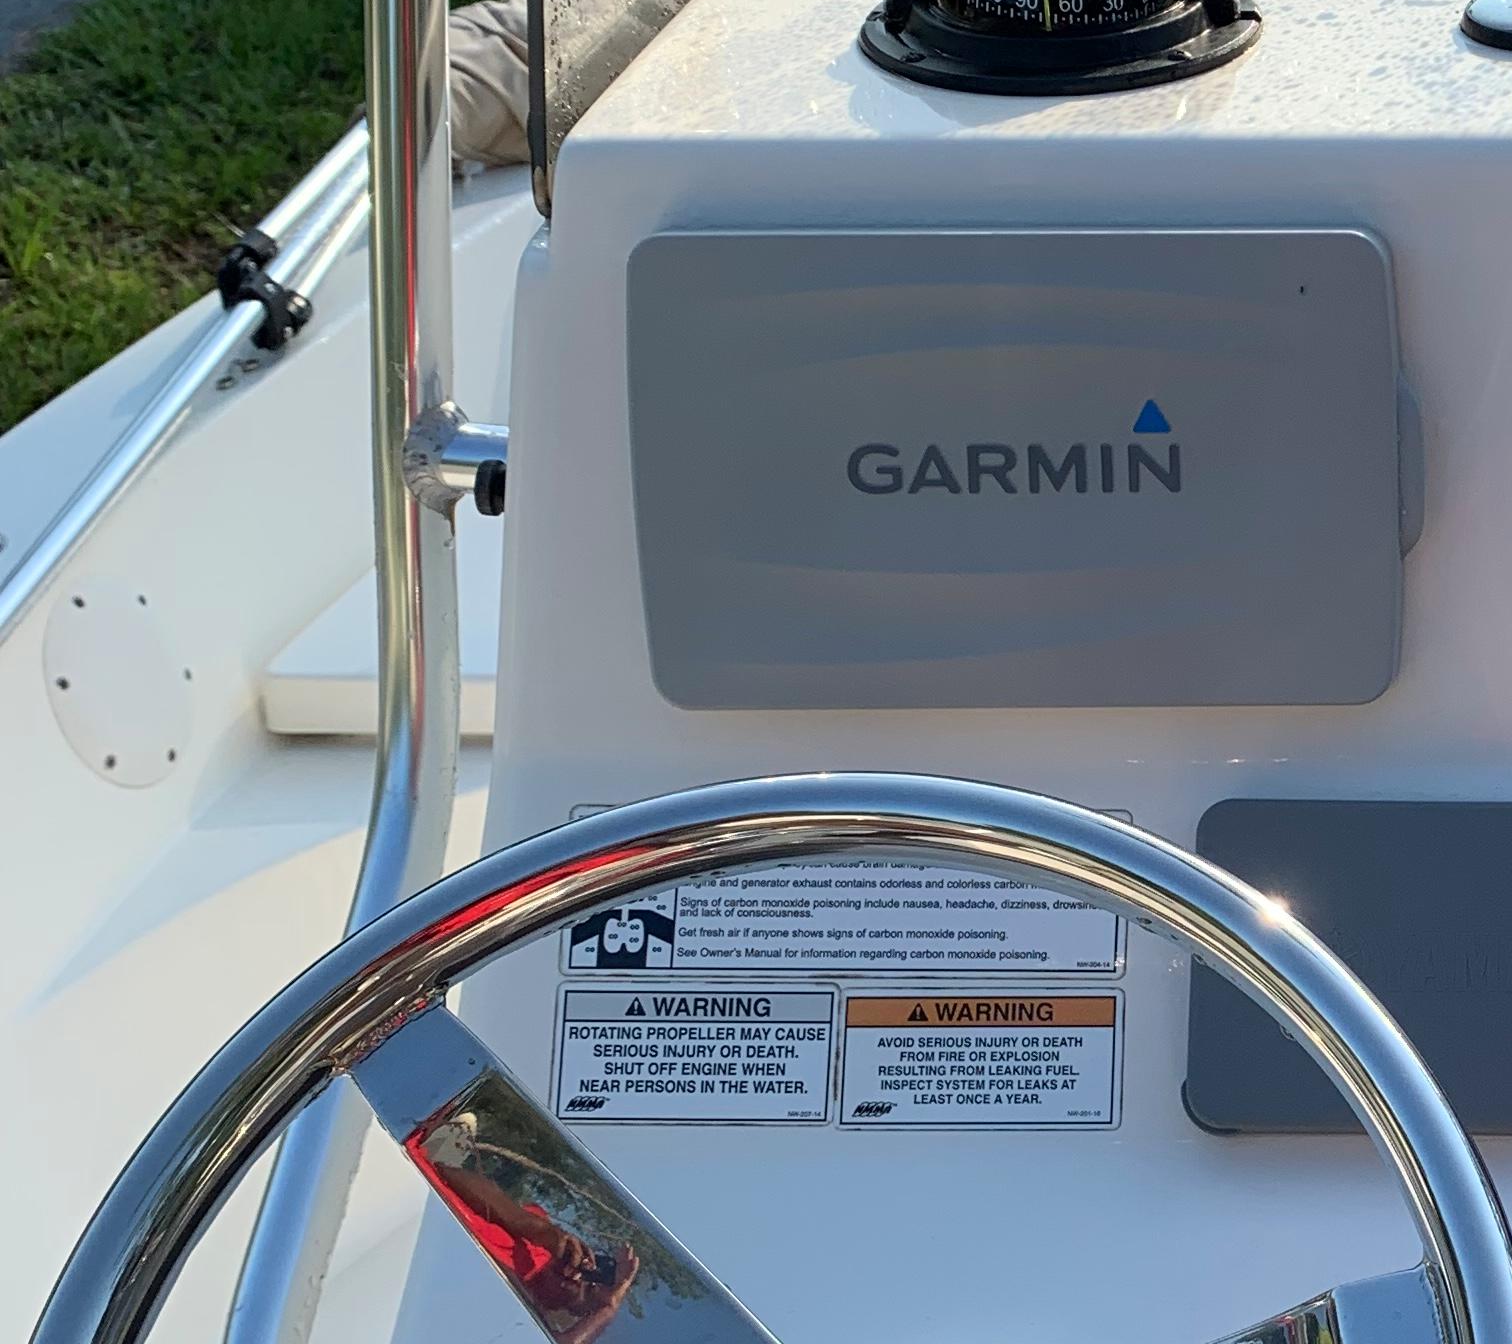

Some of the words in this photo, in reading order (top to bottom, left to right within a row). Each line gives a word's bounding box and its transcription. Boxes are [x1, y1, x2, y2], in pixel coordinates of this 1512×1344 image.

[846, 443, 1182, 495] GARMIN
[681, 878, 717, 889] ngine
[719, 878, 738, 887] and
[741, 878, 790, 889] generator
[792, 878, 832, 888] exhaust
[834, 878, 876, 888] contains
[879, 879, 922, 888] odorless
[925, 879, 943, 889] and
[946, 879, 990, 889] colorless
[680, 896, 708, 908] Signs
[711, 896, 721, 907] of
[723, 897, 758, 908] carbon
[761, 897, 810, 908] monoxide
[813, 898, 861, 910] poisoning
[864, 898, 899, 908] include
[902, 900, 942, 909] nausea,
[945, 899, 997, 910] headache,
[1001, 899, 1049, 910] dizziness,
[1052, 898, 1098, 909] drowsin
[679, 907, 698, 917] and
[701, 907, 721, 917] lack
[724, 907, 734, 917] of
[736, 907, 815, 918] consciousness.
[678, 927, 696, 937] Get
[699, 927, 724, 937] fresh
[727, 928, 740, 937] air
[743, 927, 750, 937] if
[752, 929, 789, 940] anyone
[792, 928, 823, 938] shows
[826, 928, 853, 941] signs
[856, 928, 866, 938] of
[868, 929, 902, 938] carbon
[906, 928, 954, 939] monoxide
[957, 929, 1007, 941] poisoning.
[677, 947, 697, 957] See
[700, 947, 741, 958] Owner's
[744, 947, 781, 958] Manual
[784, 948, 798, 958] for
[801, 948, 856, 958] information
[859, 948, 907, 961] regarding
[910, 949, 944, 959] carbon
[947, 949, 996, 959] monoxide
[999, 949, 1049, 962] poisoning.
[652, 997, 770, 1017] WARNING
[935, 1002, 1052, 1022] WARNING
[569, 1026, 641, 1039] ROTATING
[646, 1026, 735, 1040] PROPELLER
[740, 1027, 771, 1040] MAY
[775, 1027, 825, 1041] CAUSE
[877, 1037, 914, 1048] AVOID
[918, 1037, 971, 1048] SERIOUS
[975, 1037, 1018, 1048] INJURY
[1021, 1037, 1039, 1047] OR
[1043, 1037, 1082, 1047] DEATH
[593, 1044, 658, 1057] SERIOUS
[663, 1044, 715, 1058] INJURY
[720, 1045, 741, 1058] OR
[746, 1045, 798, 1058] DEATH.
[900, 1051, 934, 1062] FROM
[938, 1051, 964, 1062] FIRE
[969, 1051, 986, 1062] OR
[990, 1051, 1059, 1062] EXPLOSION
[604, 1062, 644, 1075] SHUT
[648, 1062, 677, 1075] OFF
[681, 1062, 736, 1076] ENGINE
[741, 1063, 785, 1076] WHEN
[878, 1065, 945, 1076] RESULTING
[950, 1065, 984, 1076] FROM
[988, 1065, 1041, 1076] LEAKING
[1045, 1065, 1079, 1076] FUEL.
[579, 1079, 620, 1092] NEAR
[625, 1079, 695, 1093] PERSONS
[700, 1080, 714, 1093] IN
[719, 1080, 748, 1093] THE
[753, 1080, 807, 1094] WATER.
[881, 1079, 932, 1090] INSPECT
[936, 1079, 984, 1090] SYSTEM
[989, 1079, 1013, 1090] FOR
[1017, 1079, 1057, 1090] LEAKS
[1061, 1079, 1076, 1090] AT
[913, 1093, 953, 1104] LEAST
[956, 1093, 990, 1105] ONCE
[994, 1094, 1002, 1104] A
[1006, 1093, 1041, 1104] YEAR.
